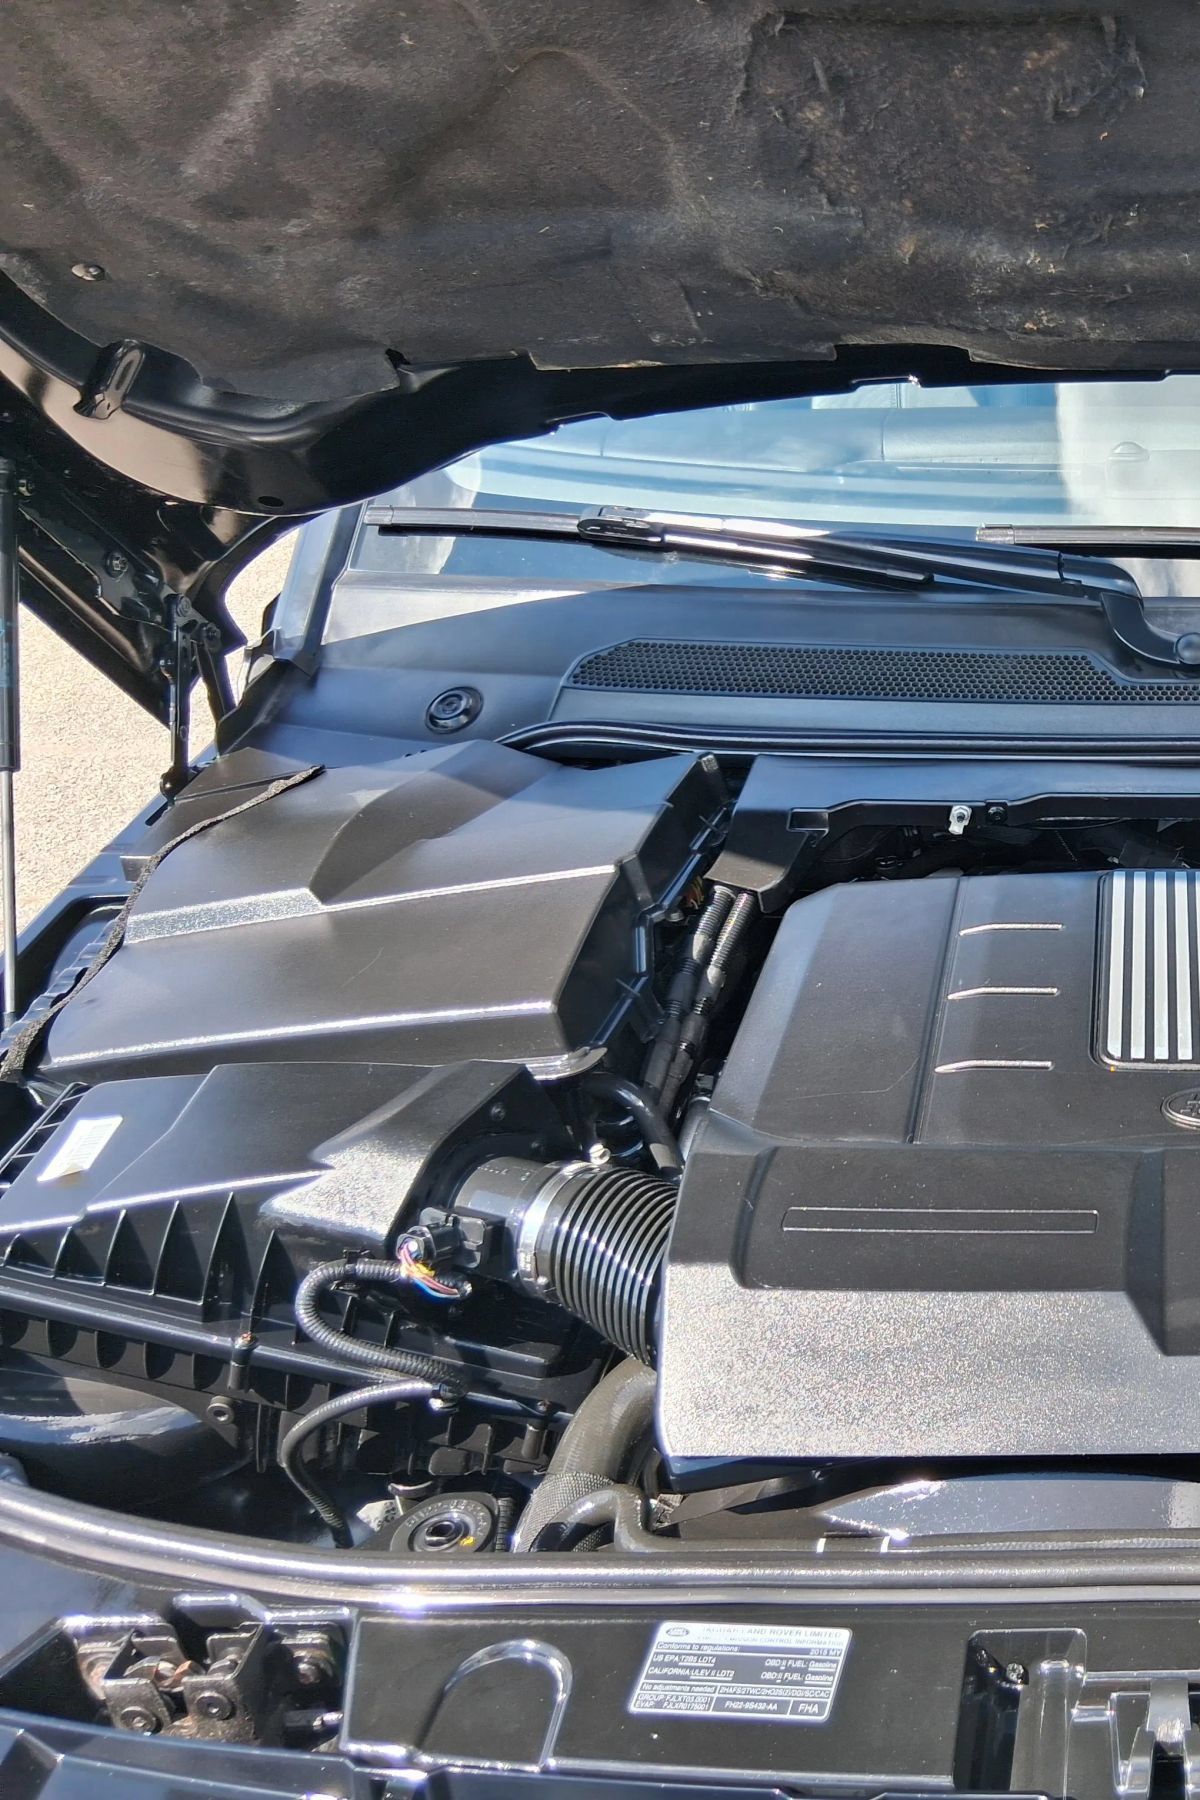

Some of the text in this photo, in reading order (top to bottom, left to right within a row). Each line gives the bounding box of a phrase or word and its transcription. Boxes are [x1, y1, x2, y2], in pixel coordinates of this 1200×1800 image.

[769, 1628, 802, 1637] ROVER
[804, 1630, 842, 1638] LIMITED
[657, 1642, 690, 1650] Conforms
[805, 1673, 834, 1681] Gasoline
[652, 1684, 690, 1692] adjustments
[691, 1685, 715, 1693] needed
[797, 1703, 819, 1713] FHA
